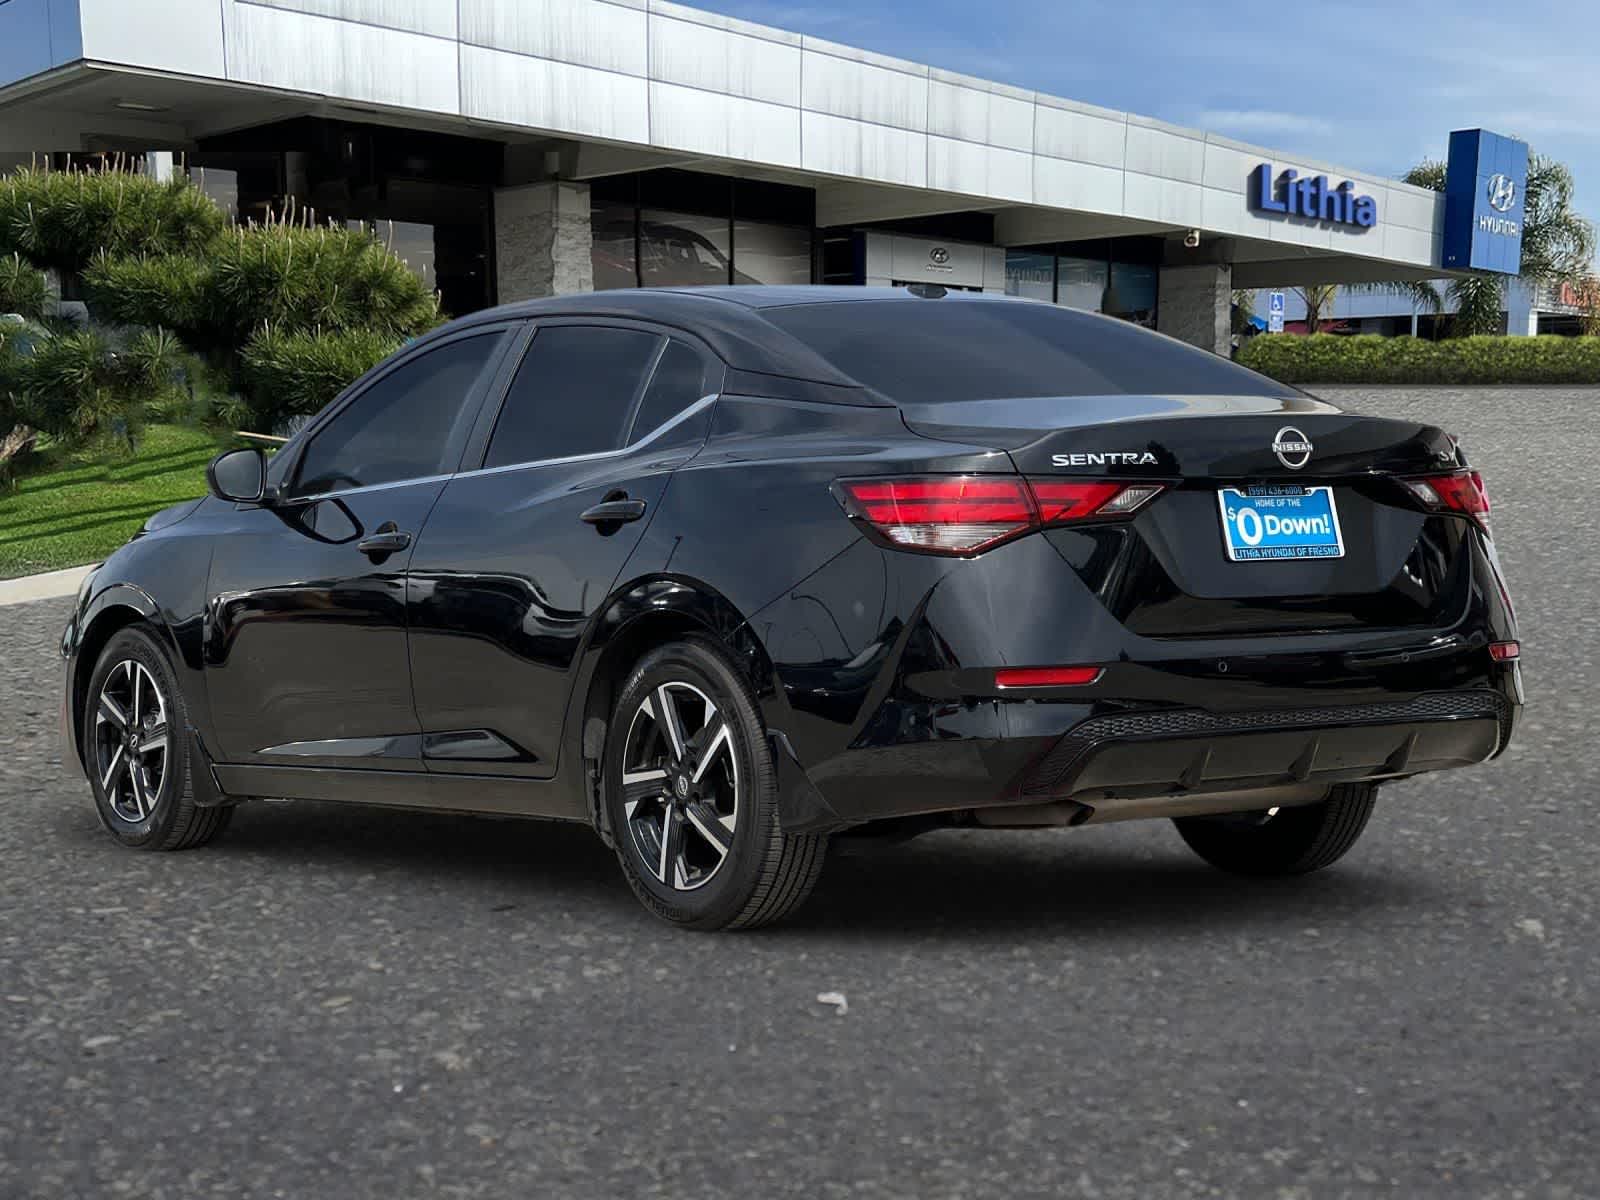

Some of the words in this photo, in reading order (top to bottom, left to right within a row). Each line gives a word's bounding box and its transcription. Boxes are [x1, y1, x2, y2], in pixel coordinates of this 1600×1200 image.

[1250, 162, 1377, 229] Lithia
[1479, 216, 1519, 237] HYUNDAI
[1272, 438, 1313, 452] NISSAN
[1051, 452, 1158, 466] SENTRA
[1255, 499, 1275, 507] HOME
[1276, 498, 1286, 507] OF
[1287, 498, 1301, 506] THE
[1264, 514, 1331, 535] Down!
[1235, 549, 1260, 558] LITHIA
[1261, 548, 1296, 558] HYUNDAI
[1297, 547, 1307, 556] OF
[1308, 546, 1339, 556] FRESNO
